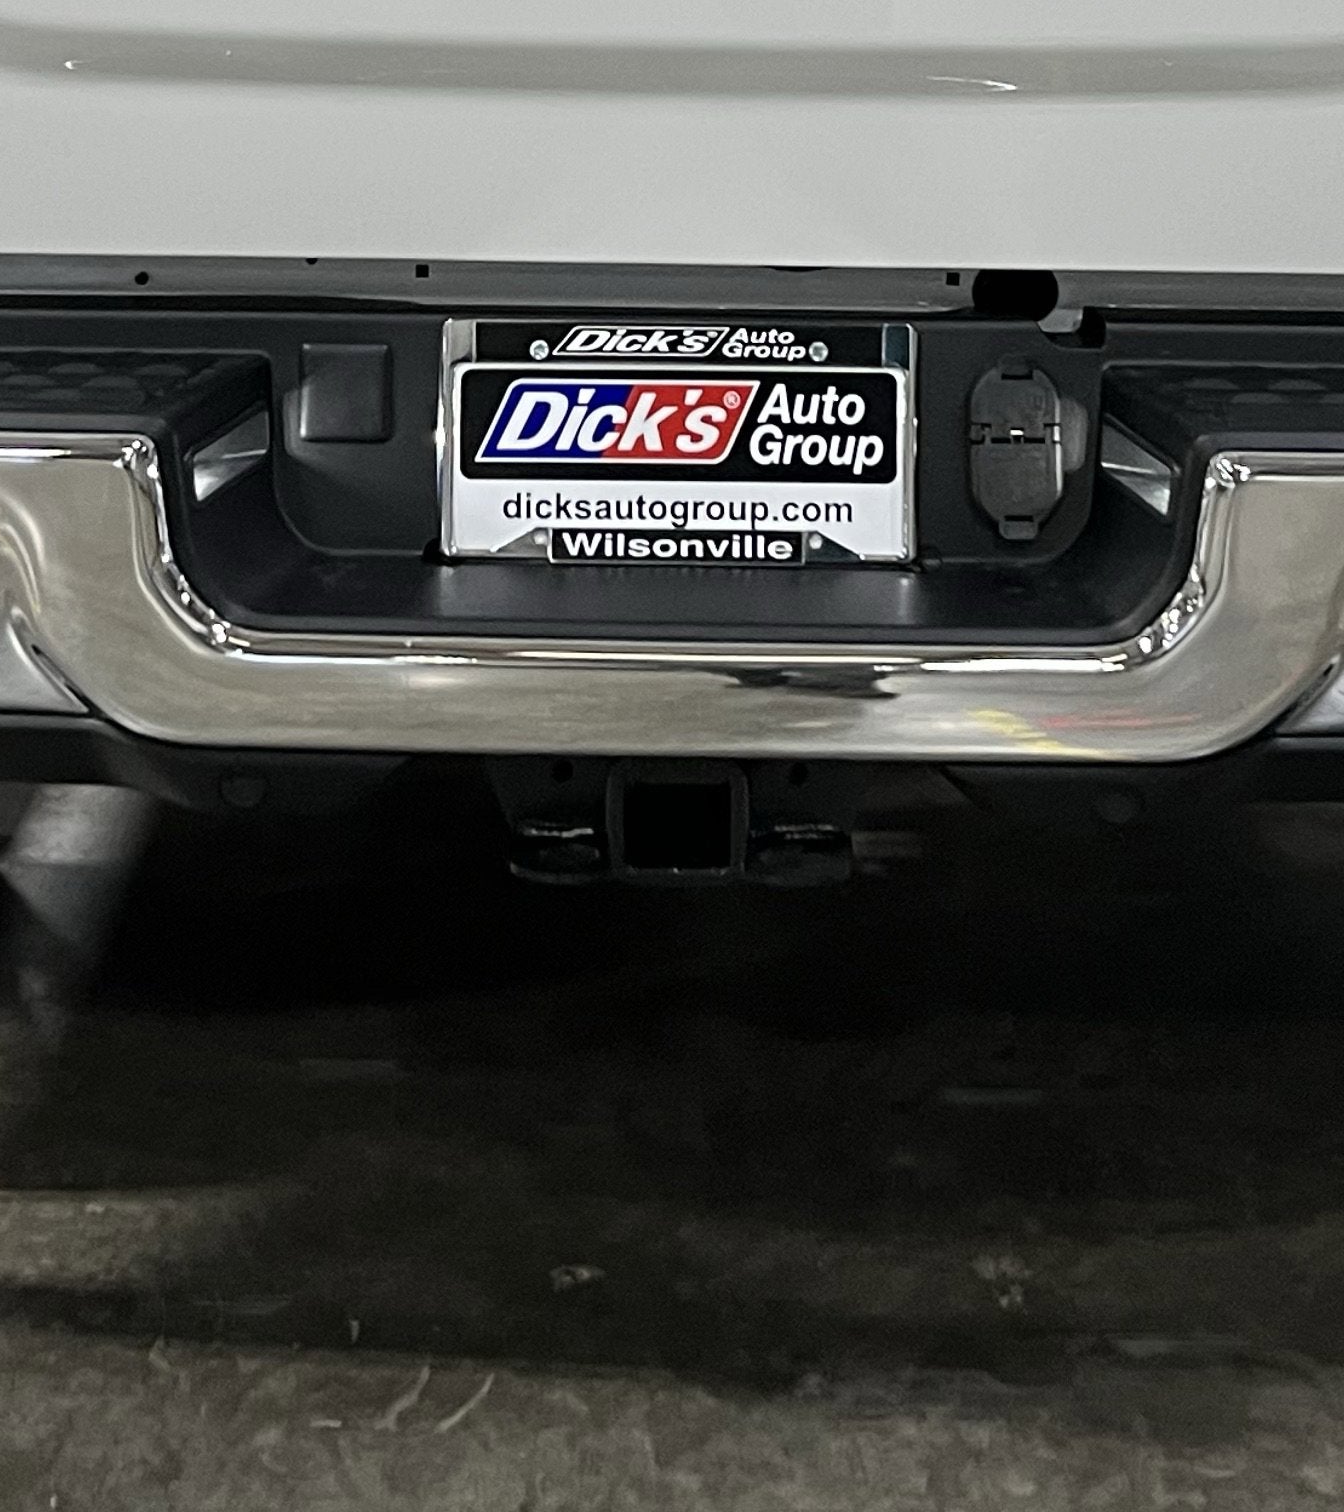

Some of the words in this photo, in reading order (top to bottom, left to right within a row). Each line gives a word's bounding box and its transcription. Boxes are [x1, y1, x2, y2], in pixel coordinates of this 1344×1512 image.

[566, 328, 717, 354] Dick's
[730, 327, 796, 346] Auto
[721, 342, 807, 362] Group
[495, 388, 728, 455] Dick's
[757, 384, 867, 426] Auto
[749, 424, 885, 475] Group
[502, 492, 855, 529] dicksautogroup.com
[561, 531, 794, 560] Wilsonville
